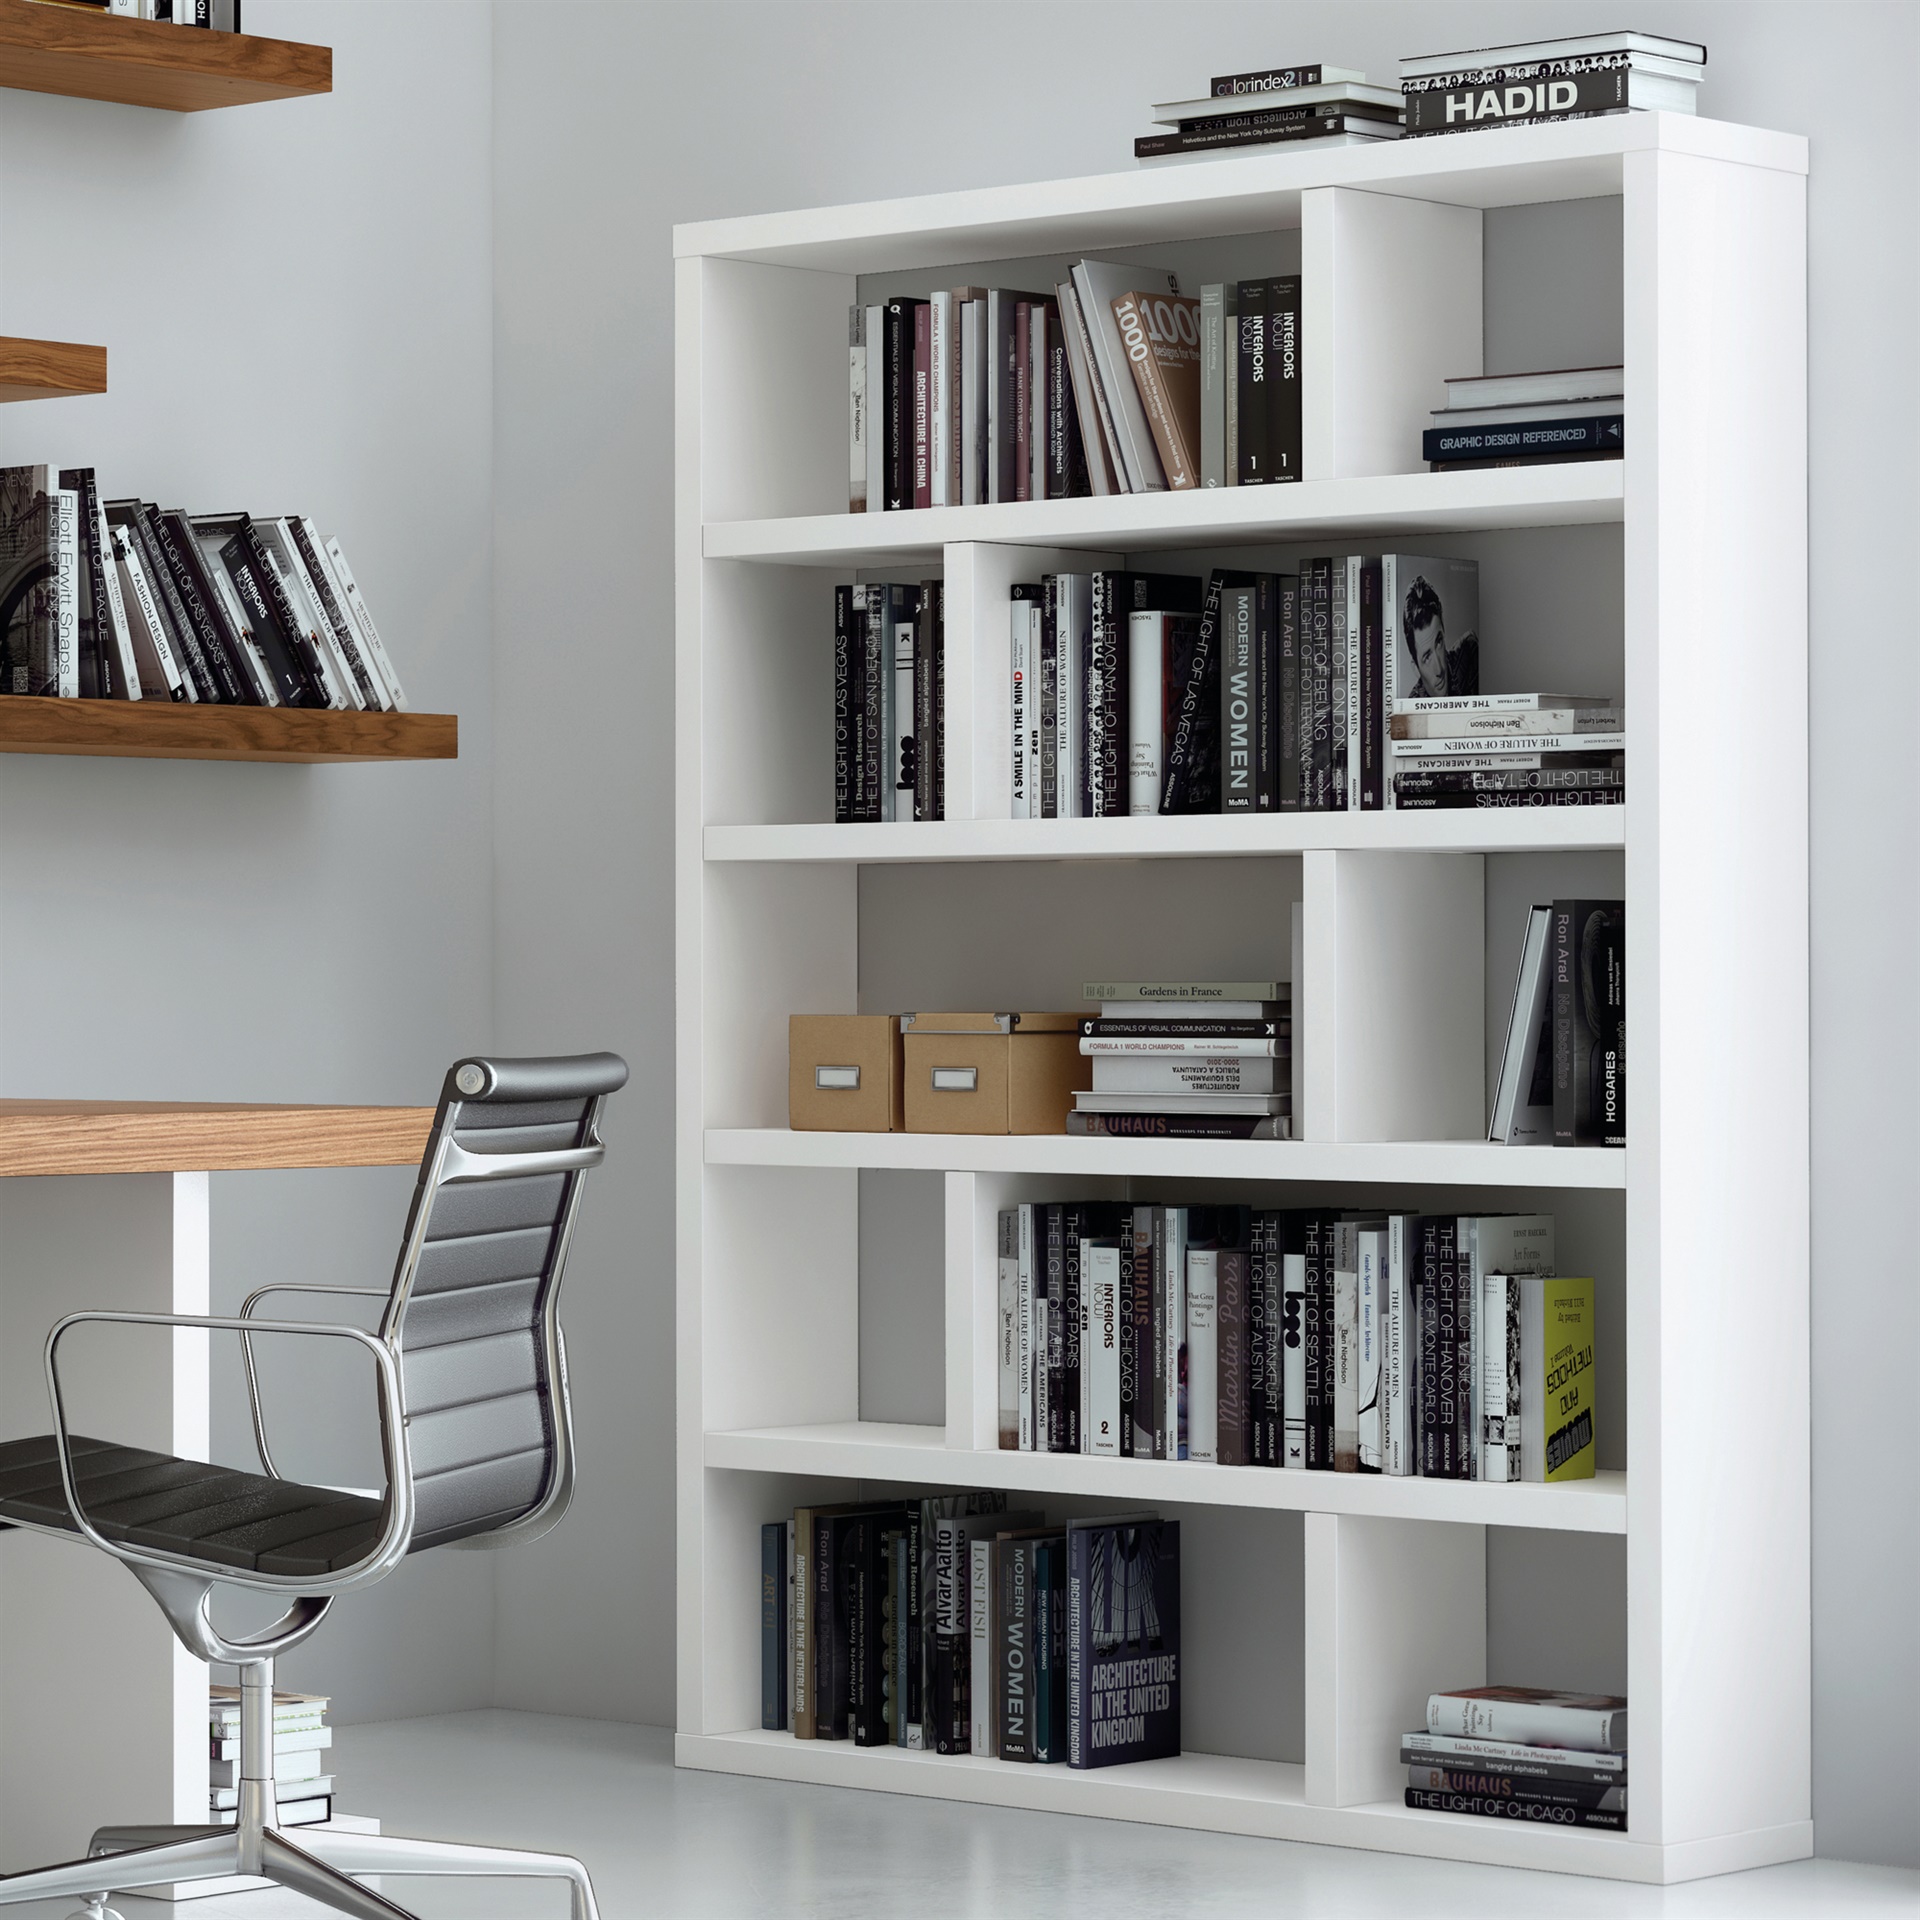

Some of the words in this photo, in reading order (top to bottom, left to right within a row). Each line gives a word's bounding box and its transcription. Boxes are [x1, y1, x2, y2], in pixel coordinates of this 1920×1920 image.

[1446, 81, 1577, 123] HADID
[1182, 136, 1206, 144] Helvetica
[1116, 301, 1148, 361] 1000
[1242, 316, 1252, 353] NOW!
[1273, 313, 1283, 350] NOW!
[1283, 312, 1294, 379] INTERIORS
[1253, 315, 1263, 382] INTERIORS
[917, 371, 926, 442] ARCHITECTURE
[917, 443, 926, 456] IN
[1440, 436, 1482, 449] GRAPHIC
[1485, 433, 1520, 446] DESIGN
[1523, 428, 1586, 444] REFERENCED
[917, 458, 926, 488] CHINA
[1251, 456, 1256, 469] 1
[1282, 454, 1286, 467] 1
[60, 495, 73, 545] Elliott
[60, 553, 73, 605] Erwitt
[241, 565, 268, 619] INTERIORS
[1333, 565, 1345, 598] THE
[133, 572, 154, 619] FASHION
[150, 621, 168, 659] DESIGN
[1284, 592, 1294, 619] Ron
[1237, 596, 1248, 665] MODERN
[1284, 624, 1294, 657] Arad
[1333, 602, 1345, 649] LIGHT
[60, 612, 73, 675] Snaps
[837, 635, 847, 684] VEGAS
[1060, 672, 1066, 686] OF
[1333, 652, 1345, 674] OF
[837, 685, 847, 716] LAS
[1014, 671, 1023, 704] MIND
[1350, 696, 1357, 710] OF
[1014, 708, 1023, 731] THE
[1333, 678, 1345, 750] LONDON
[1415, 701, 1469, 710] AMERICANS
[837, 720, 847, 740] OF
[1014, 734, 1023, 746] IN
[1231, 672, 1247, 788] WOMEN
[837, 744, 847, 786] LIGHT
[1014, 748, 1023, 788] SMILE
[837, 787, 847, 817] THE
[1014, 790, 1023, 799] A
[1228, 798, 1249, 806] MoMA
[1558, 914, 1569, 943] Ron
[1558, 948, 1569, 983] Arad
[1139, 987, 1177, 996] Gardens
[1180, 987, 1188, 996] in
[1190, 987, 1222, 996] France
[1100, 1024, 1137, 1032] ESSENTIALS
[1139, 1024, 1147, 1032] OF
[1148, 1024, 1169, 1032] VISUAL
[1171, 1024, 1226, 1032] COMMUNICATION
[1606, 1051, 1615, 1122] HOGARES
[1086, 1117, 1166, 1134] BAUHAUS
[1307, 1222, 1318, 1254] THE
[1440, 1226, 1453, 1259] THE
[1135, 1232, 1148, 1325] BAUHAUS
[1220, 1257, 1238, 1323] Parr
[1307, 1258, 1318, 1304] LIGHT
[1440, 1263, 1453, 1311] LIGHT
[1094, 1283, 1103, 1319] NOW!
[1104, 1284, 1113, 1348] INTERIORS
[1307, 1308, 1318, 1331] OF
[1440, 1314, 1453, 1338] OF
[1220, 1331, 1238, 1430] Martin
[1307, 1334, 1318, 1406] SEATTLE
[1440, 1342, 1453, 1424] HANOVER
[1101, 1421, 1108, 1434] 2
[796, 1554, 805, 1620] ARCHITECTURE
[974, 1548, 985, 1594] LOST
[1015, 1548, 1024, 1617] MODERN
[796, 1622, 805, 1631] IN
[974, 1600, 985, 1638] FISH
[1071, 1577, 1080, 1650] ARCHITECTURE
[796, 1633, 805, 1649] THE
[1071, 1651, 1080, 1660] IN
[796, 1650, 805, 1712] NETHERLANDS
[1008, 1623, 1023, 1735] WOMEN
[1071, 1661, 1080, 1679] THE
[1092, 1655, 1176, 1691] ARCHITECTURE
[1071, 1682, 1080, 1716] UNITED
[1092, 1693, 1102, 1720] IN
[1106, 1689, 1126, 1717] THE
[1128, 1683, 1169, 1713] UNITED
[1006, 1744, 1024, 1753] MoMA
[1071, 1718, 1080, 1765] KINGDOM
[1092, 1716, 1144, 1748] KINGDOM
[1454, 1743, 1472, 1751] Linda
[1430, 1771, 1511, 1795] BAUHAUS
[1486, 1763, 1511, 1772] tangled
[1514, 1765, 1548, 1774] alphabets
[1412, 1791, 1440, 1805] THE
[1442, 1794, 1482, 1811] LIGHT
[1485, 1800, 1504, 1814] OF
[1507, 1803, 1575, 1823] CHICAGO
[1586, 1814, 1618, 1824] ASSOULINE
